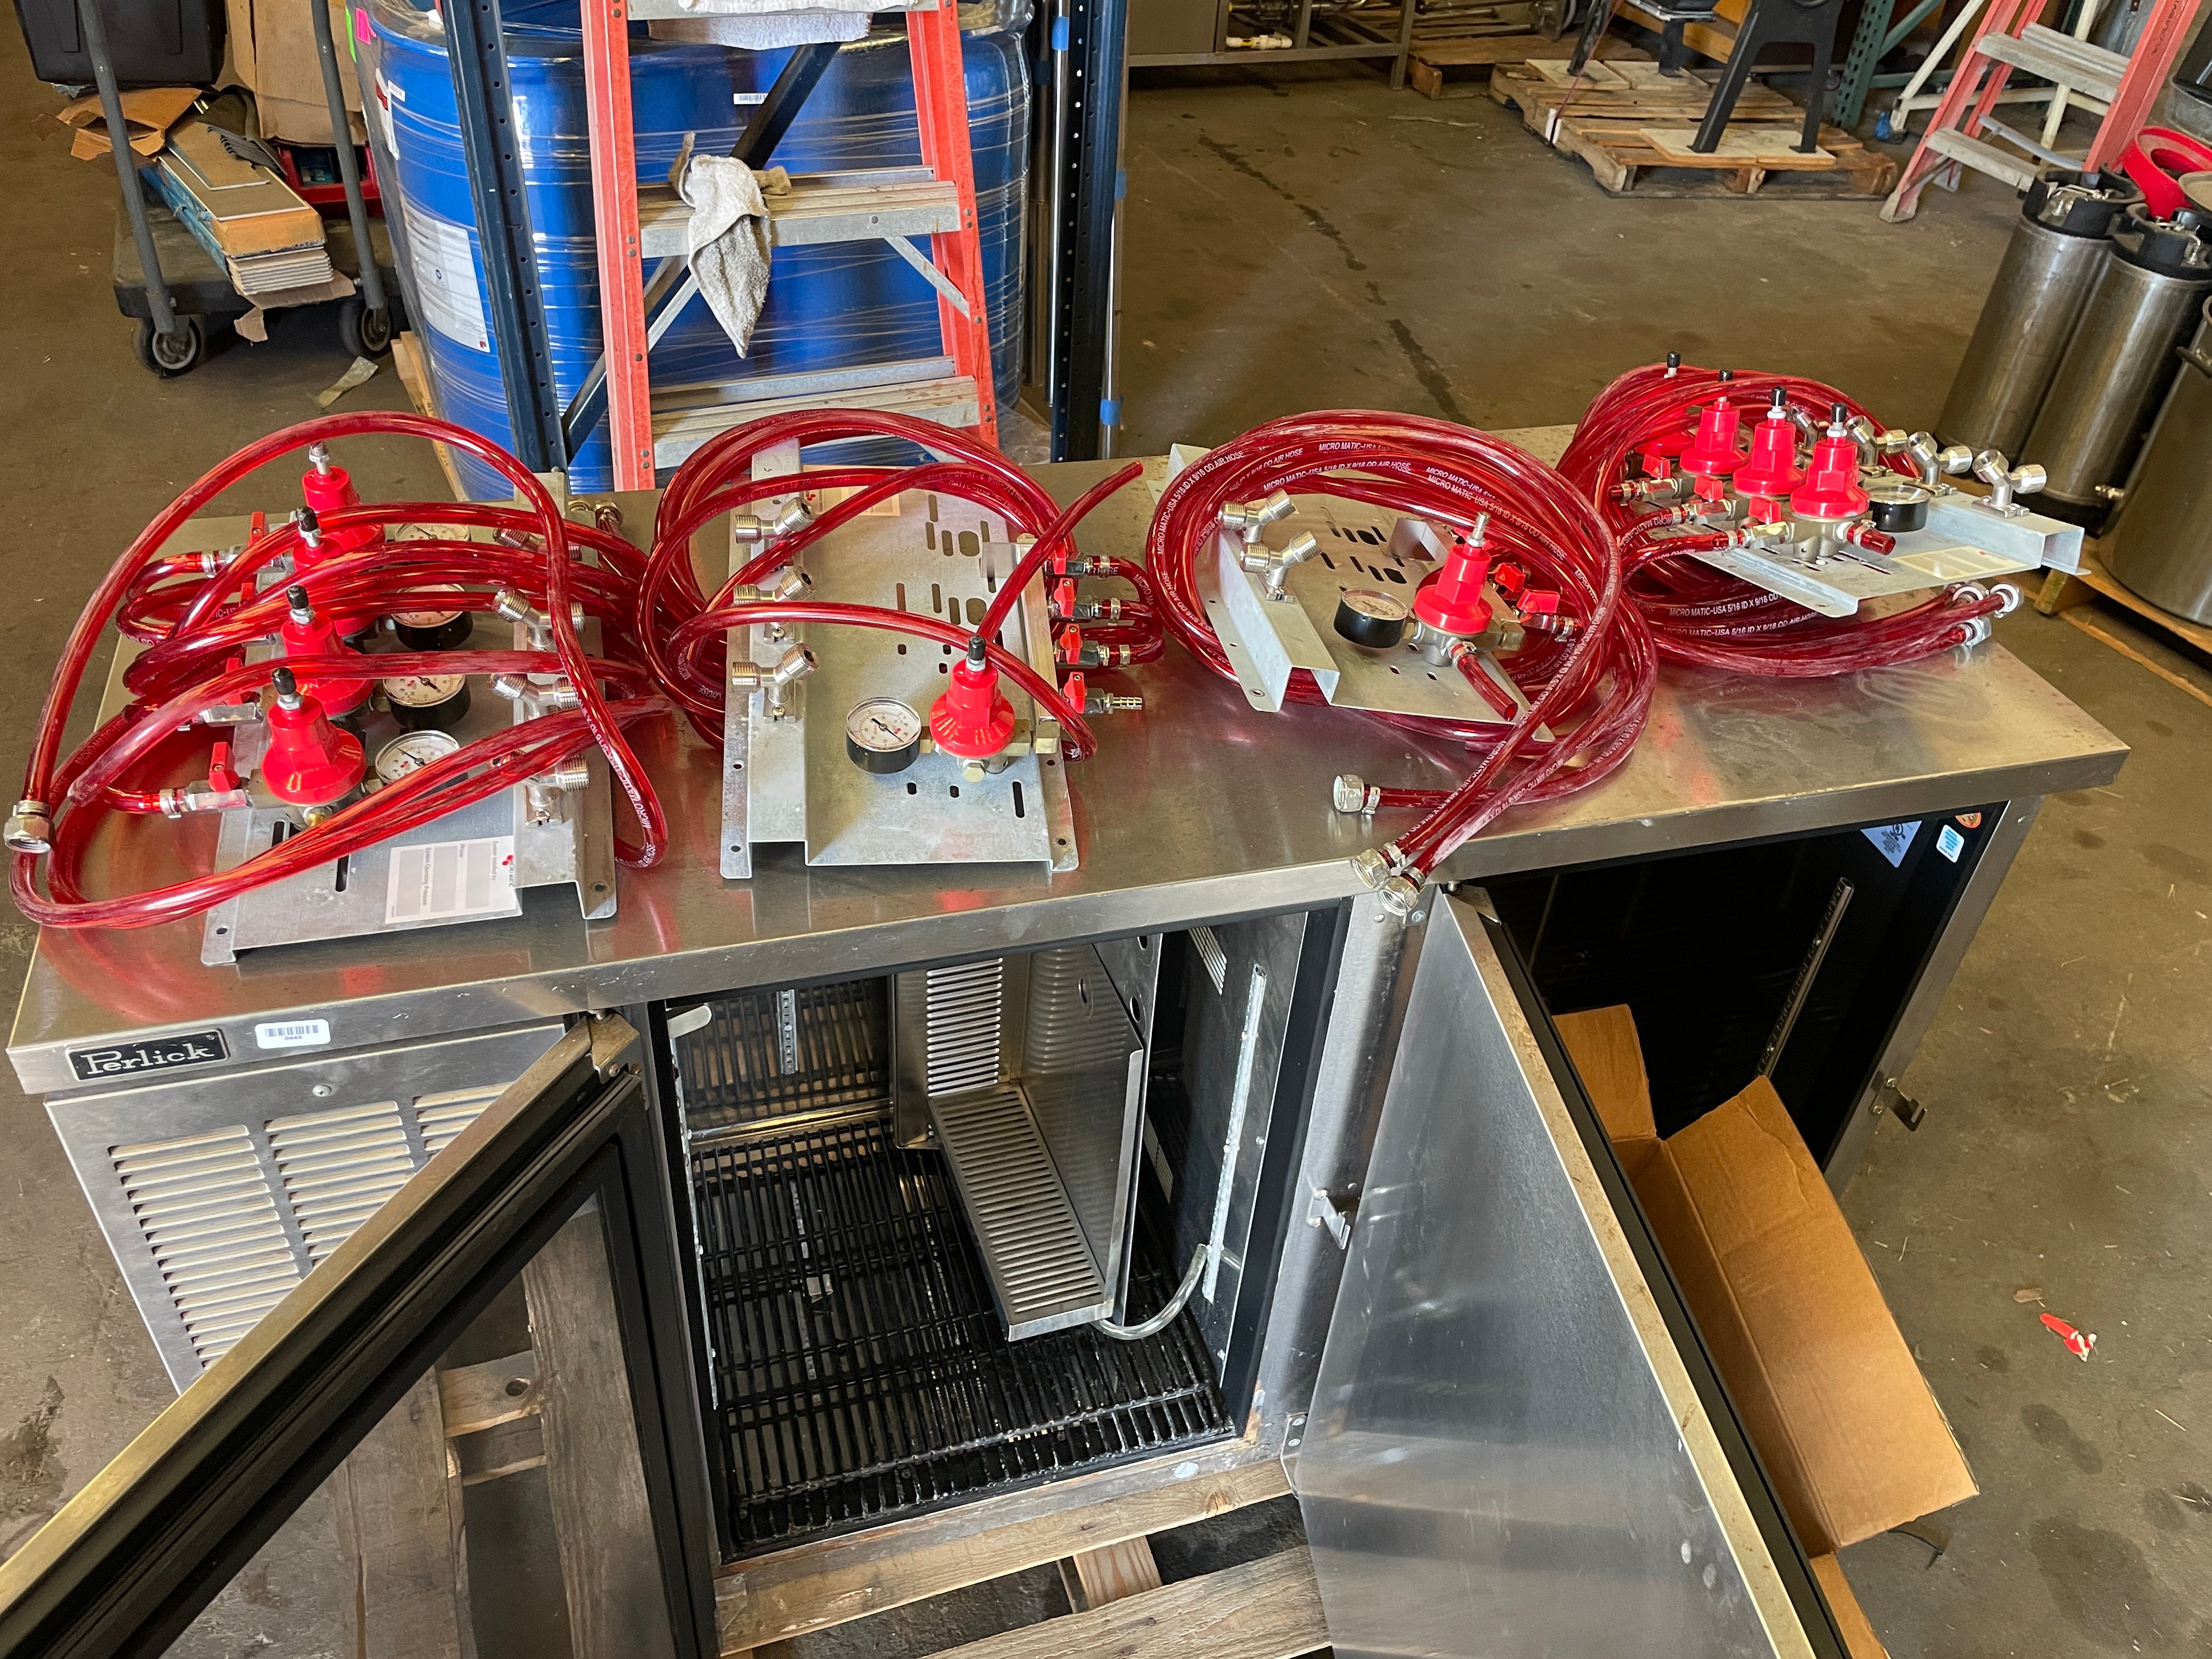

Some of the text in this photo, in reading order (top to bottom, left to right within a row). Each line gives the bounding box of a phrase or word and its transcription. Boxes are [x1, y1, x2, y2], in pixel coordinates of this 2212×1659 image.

[1285, 448, 1304, 460] HOSE
[1318, 442, 1340, 452] MICRO
[1340, 442, 1376, 451] MATIC-USA
[1214, 457, 1227, 467] AIR
[1224, 450, 1245, 461] HOSE
[1204, 463, 1215, 473] OD
[1182, 481, 1191, 490] ID
[1187, 476, 1196, 485] X
[1263, 477, 1285, 492] MICRO
[1285, 466, 1322, 485] MATIC-USA
[1426, 466, 1449, 478] MICRO
[1447, 473, 1483, 493] MATIC-USA
[1173, 487, 1187, 500] 5/16
[1427, 473, 1451, 490] MICRO
[1451, 484, 1489, 509] MATIC-USA
[1158, 498, 1179, 533] MATIC-USA
[1157, 532, 1166, 555] MICRO
[1132, 573, 1152, 595] MICRO
[1160, 571, 1174, 590] HOSE
[1169, 590, 1181, 601] AIR
[1177, 601, 1188, 612] OD
[1669, 592, 1779, 617] MICRO MATIC-USA 5/16 ID X 9/16 OD
[1689, 628, 1730, 636] MATIC-USA
[1731, 627, 1747, 635] 5/16
[1763, 622, 1777, 631] 9/16
[1537, 690, 1549, 702] OD
[590, 724, 598, 735] ID
[1486, 740, 1507, 760] MICRO
[1545, 758, 1564, 777] MICRO
[636, 803, 652, 830] MICRO
[80, 1042, 215, 1075] Perlick
